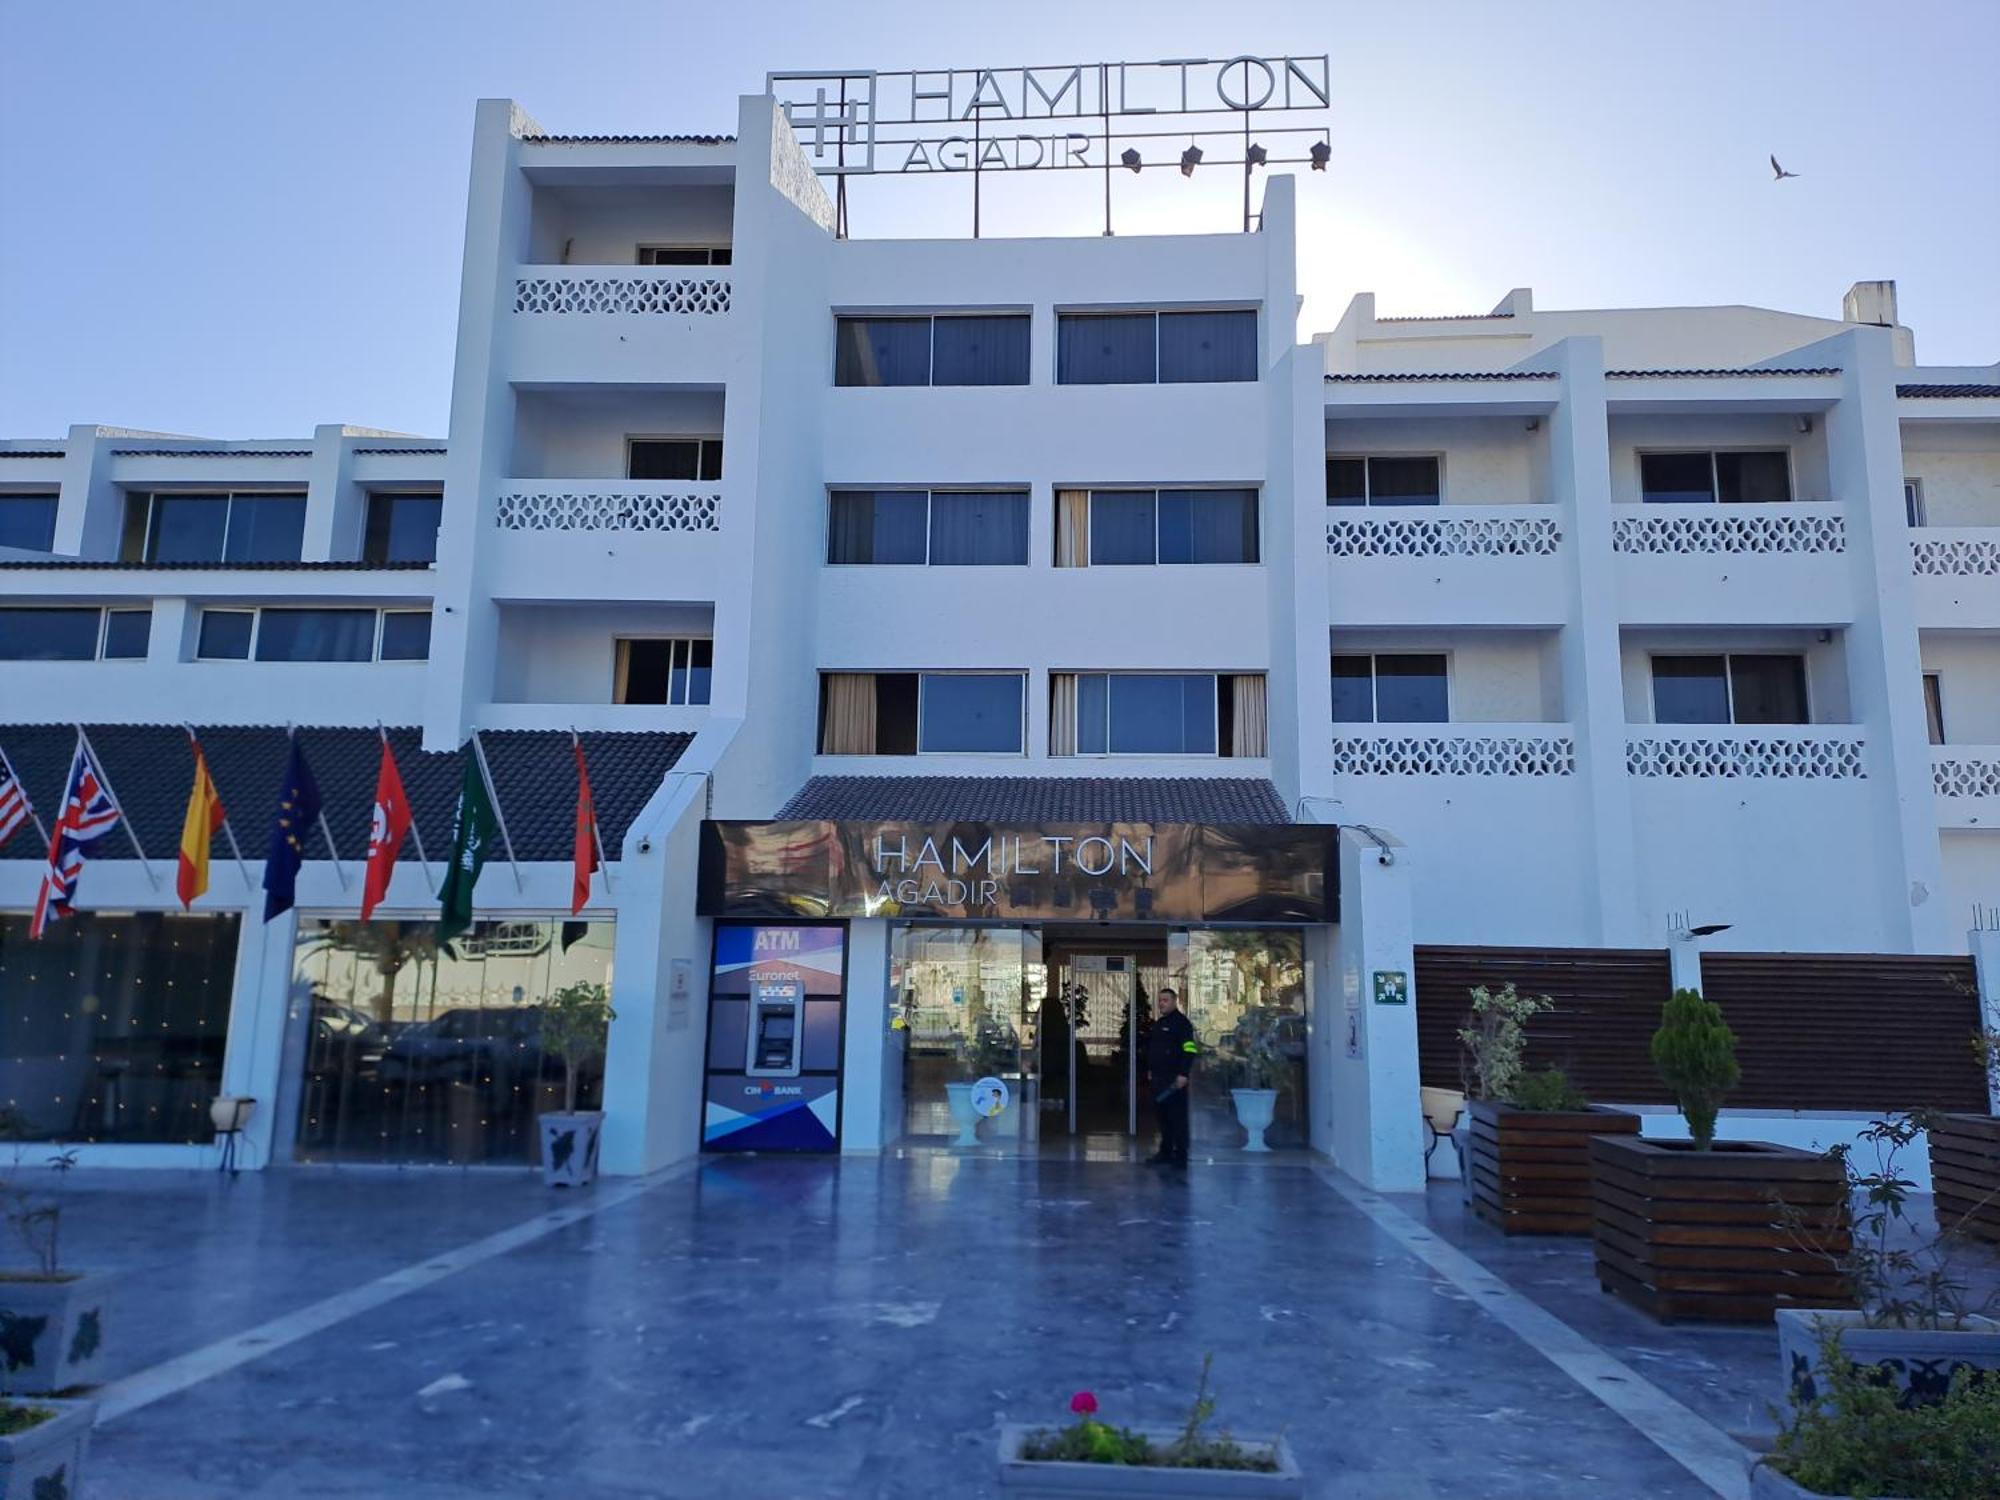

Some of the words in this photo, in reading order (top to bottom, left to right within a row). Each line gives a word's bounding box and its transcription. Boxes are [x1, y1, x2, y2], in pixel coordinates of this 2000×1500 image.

[911, 54, 1330, 122] HAMILTON
[901, 132, 1091, 172] AGADIR
[874, 835, 1154, 876] HAMILTON
[876, 879, 998, 905] AGADIR
[753, 930, 801, 951] ATM
[748, 969, 801, 982] Euronet
[773, 1086, 803, 1096] BANK
